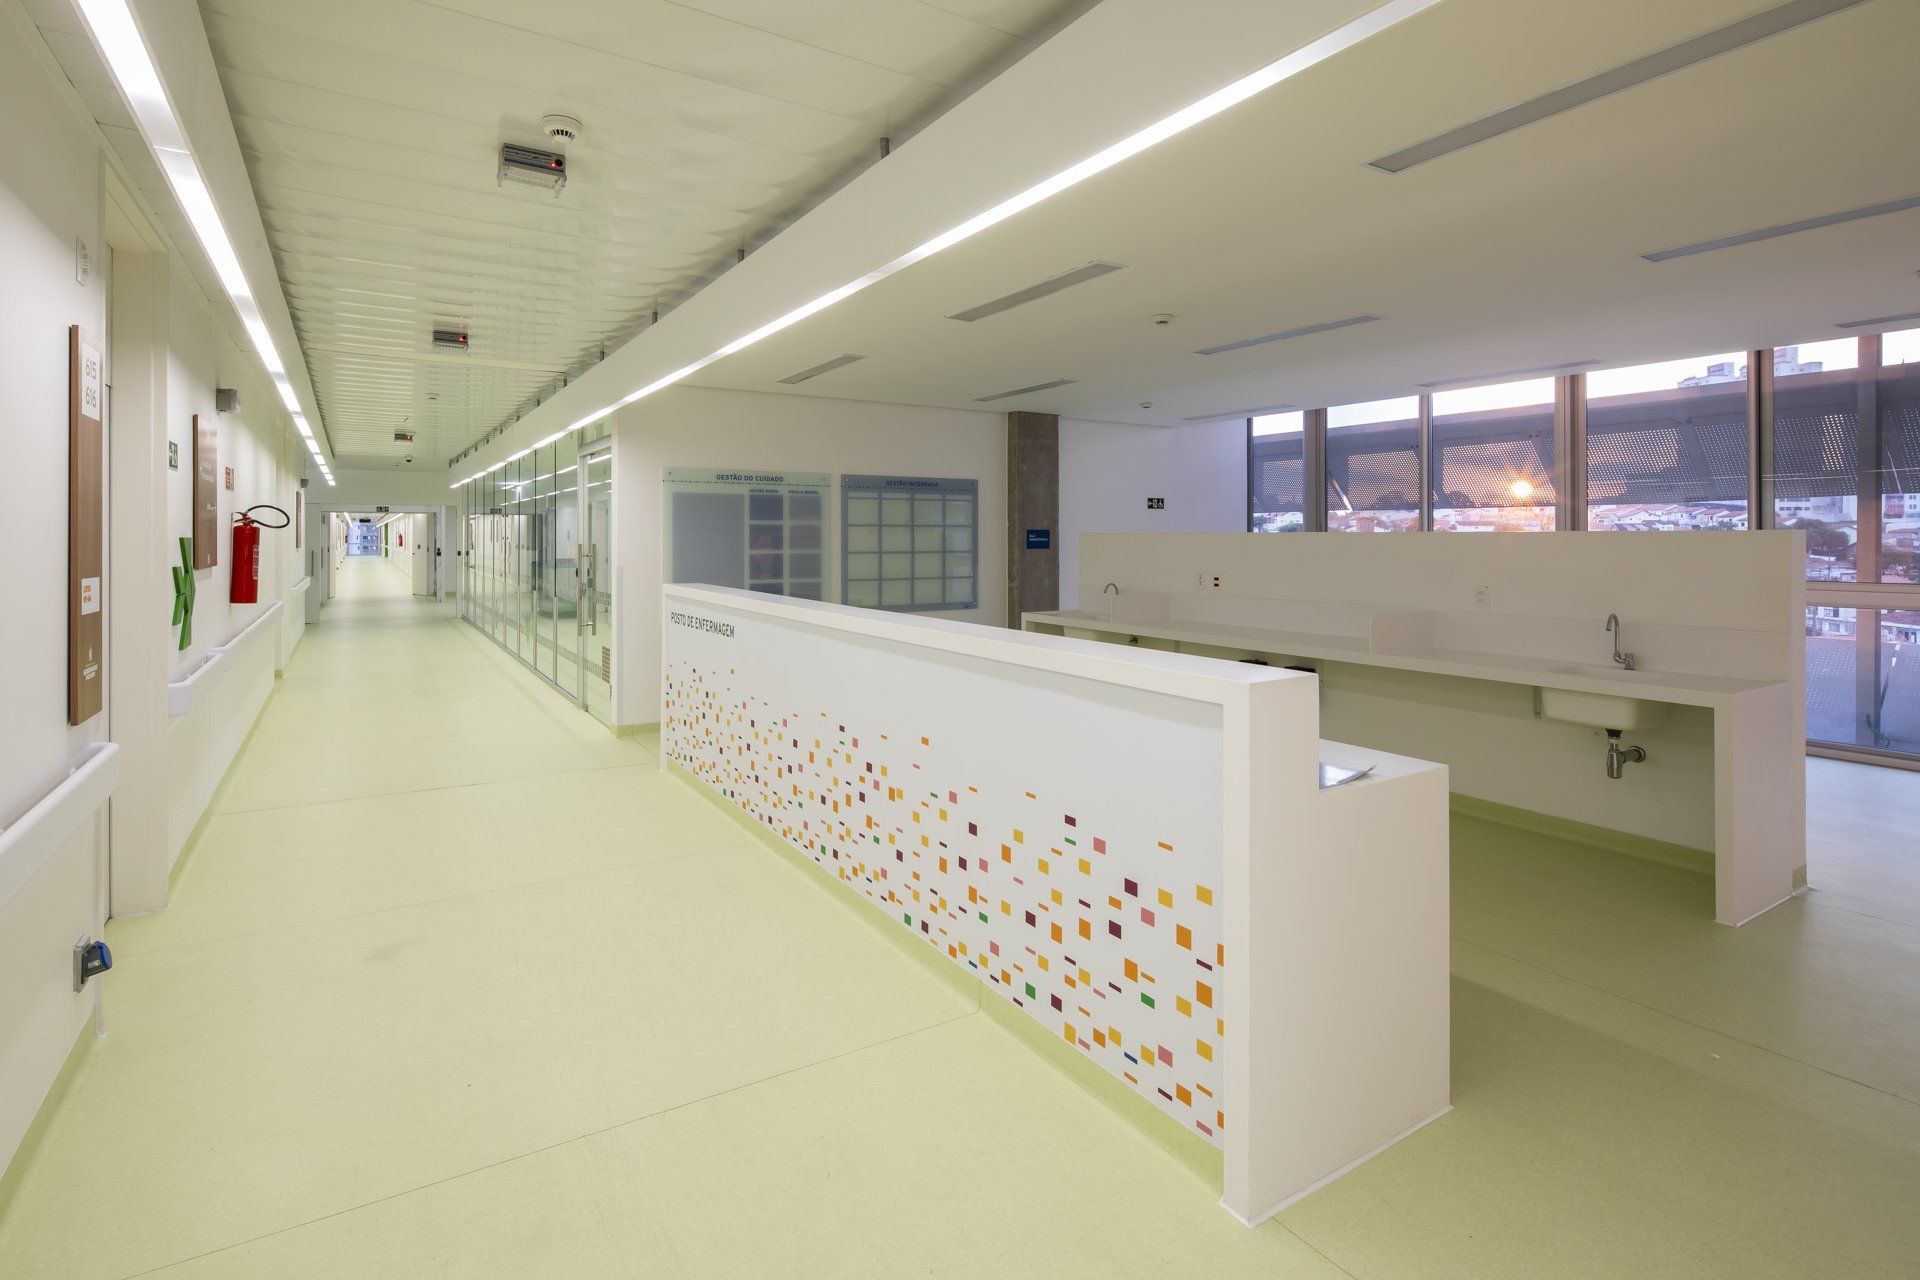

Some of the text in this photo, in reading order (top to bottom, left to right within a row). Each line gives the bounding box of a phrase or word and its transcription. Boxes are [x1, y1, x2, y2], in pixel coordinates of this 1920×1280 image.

[85, 358, 97, 381] 615
[85, 385, 97, 409] 616
[716, 473, 743, 482] GESTÃO
[755, 475, 784, 483] CUIDADO
[885, 479, 907, 487] GESTÃO
[670, 611, 736, 639] POSTO DE ENFERMAGEM
